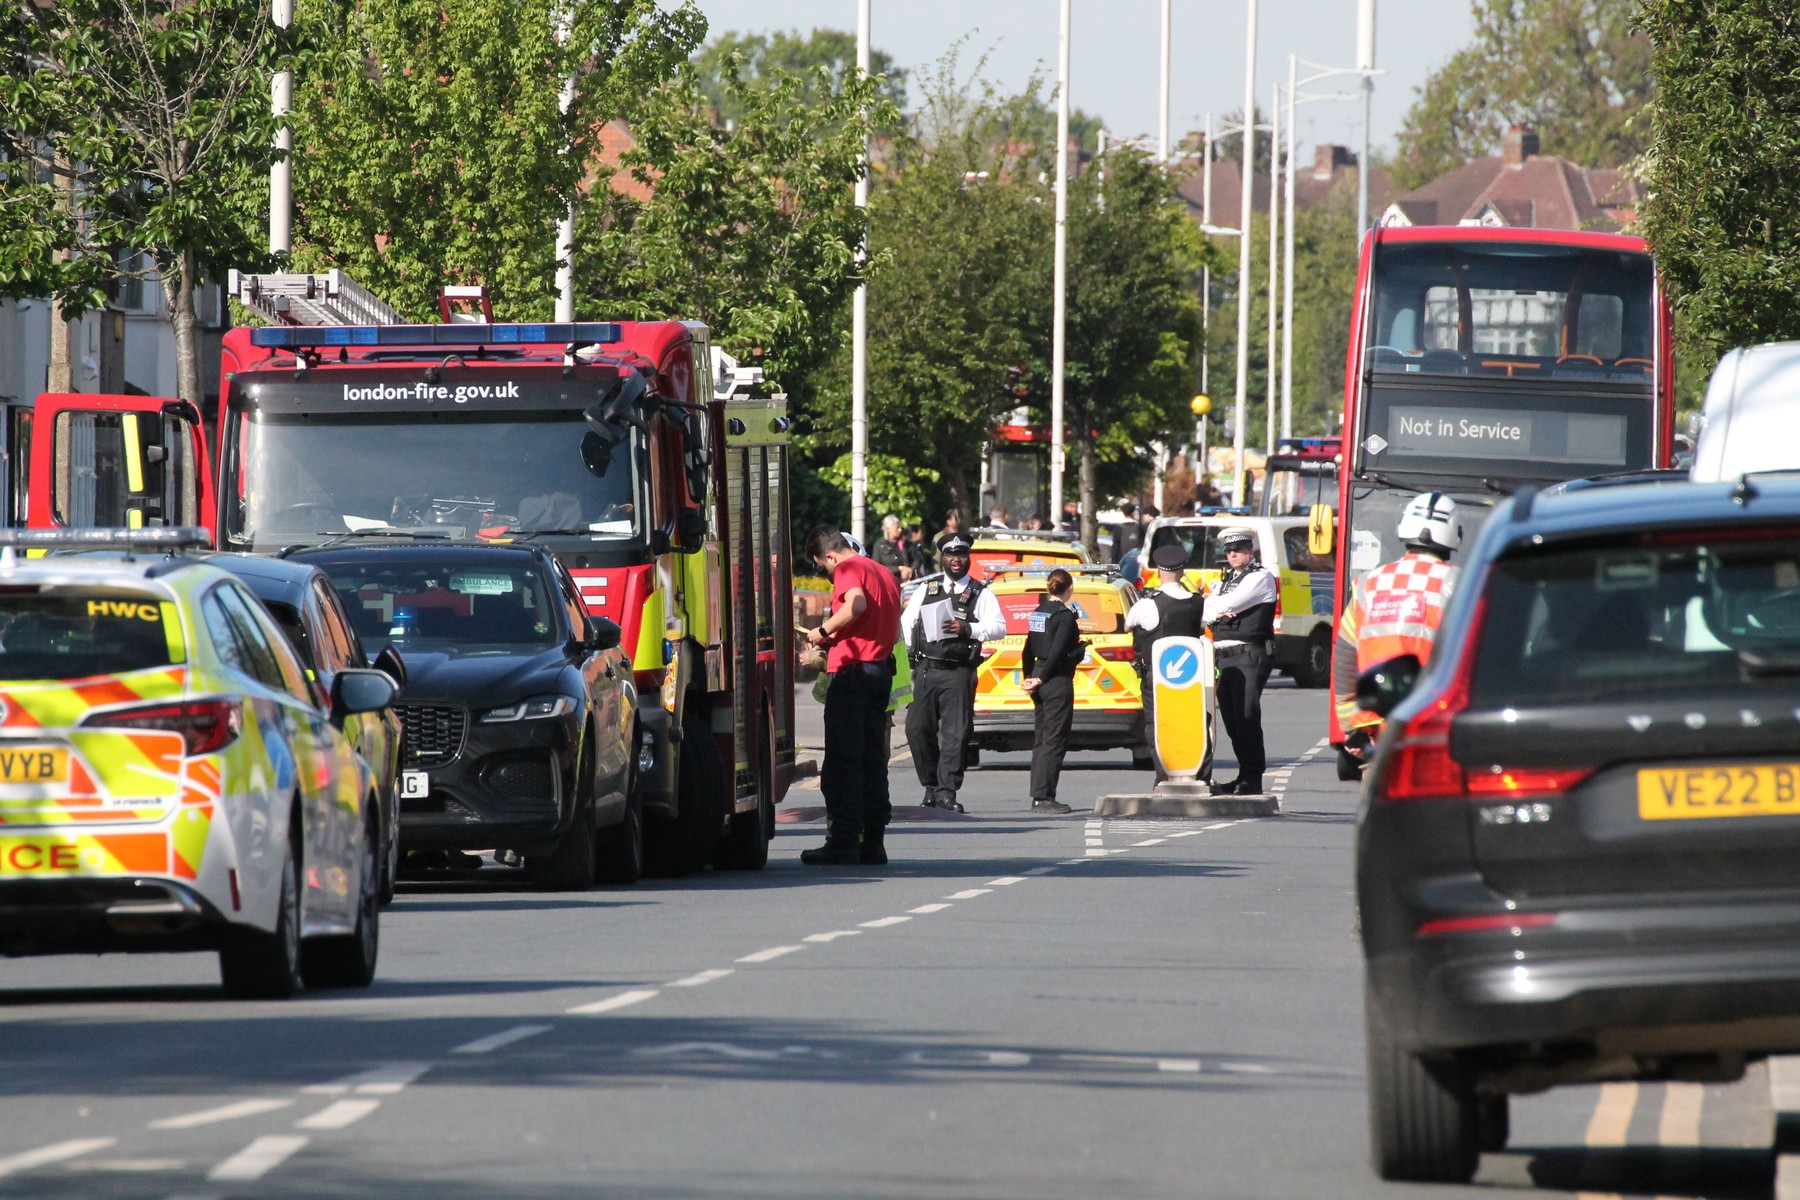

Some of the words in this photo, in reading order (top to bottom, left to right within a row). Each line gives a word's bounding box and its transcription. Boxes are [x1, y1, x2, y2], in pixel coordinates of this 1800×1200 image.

[343, 381, 519, 403] london-fire.gov.uk
[1400, 416, 1432, 436] Not
[1438, 419, 1453, 436] in
[1459, 419, 1521, 440] Service
[87, 600, 160, 622] HWC
[0, 753, 55, 778] VYB
[1659, 768, 1760, 807] VE22
[0, 843, 79, 870] CE
